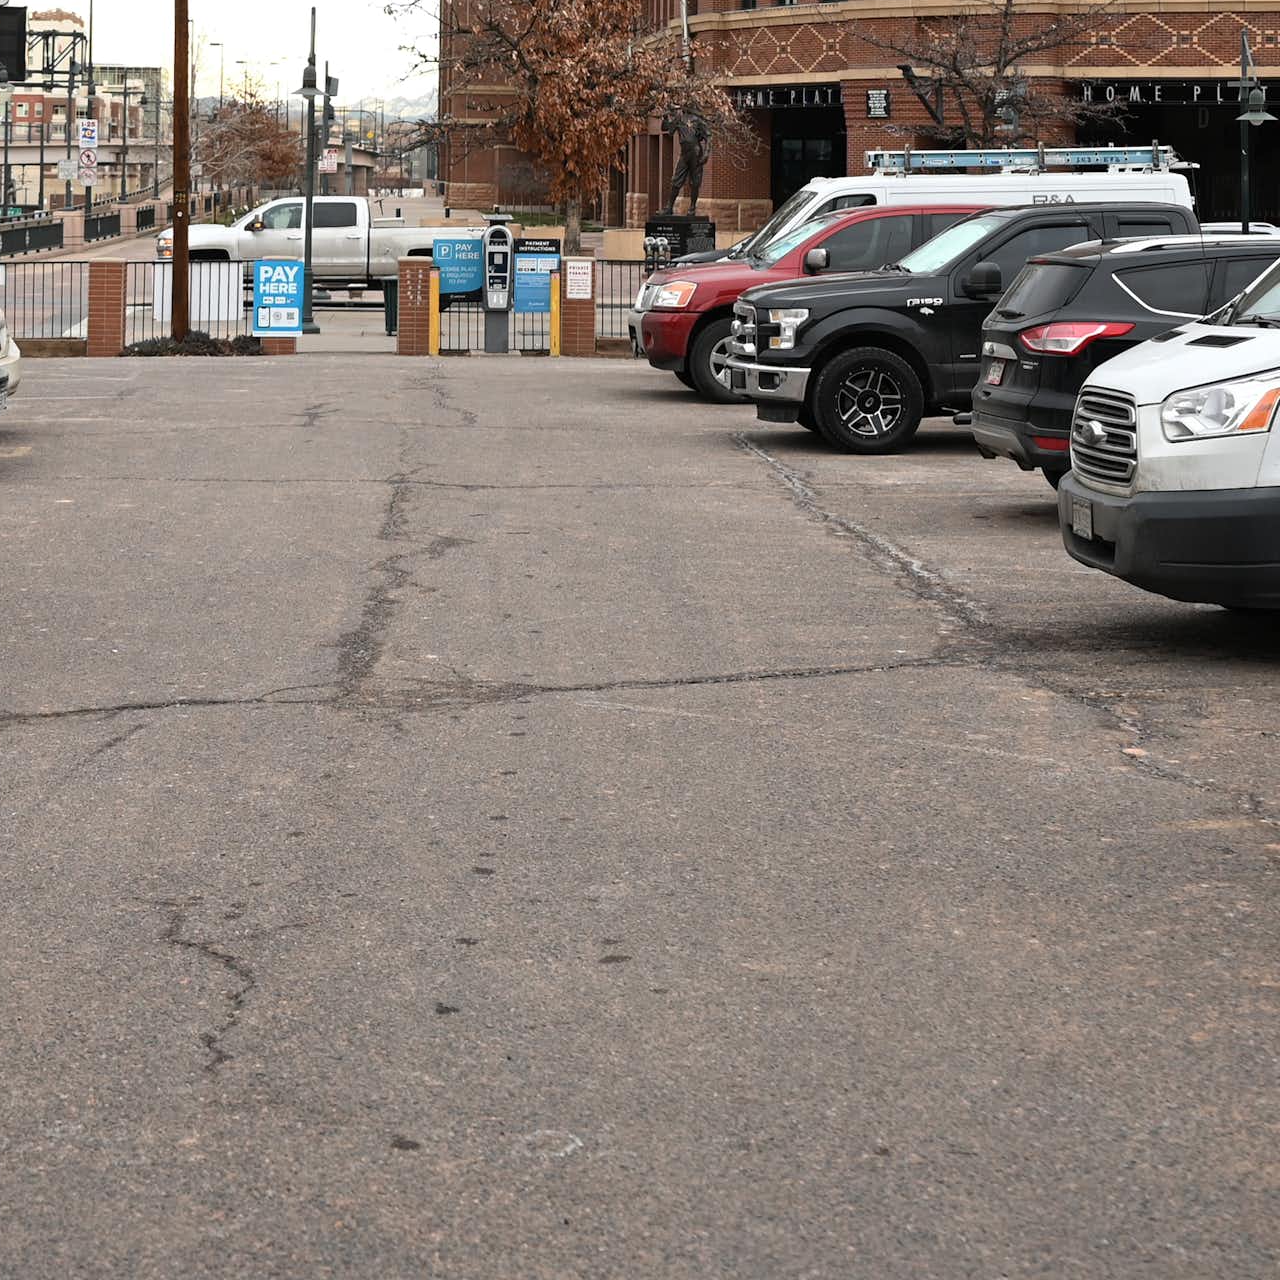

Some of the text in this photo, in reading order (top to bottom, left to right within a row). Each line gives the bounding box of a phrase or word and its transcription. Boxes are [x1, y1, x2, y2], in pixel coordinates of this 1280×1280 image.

[1083, 85, 1161, 102] HOME
[455, 243, 473, 251] PAY
[455, 251, 480, 260] HERE
[259, 265, 299, 282] PAY
[259, 282, 298, 294] HERE
